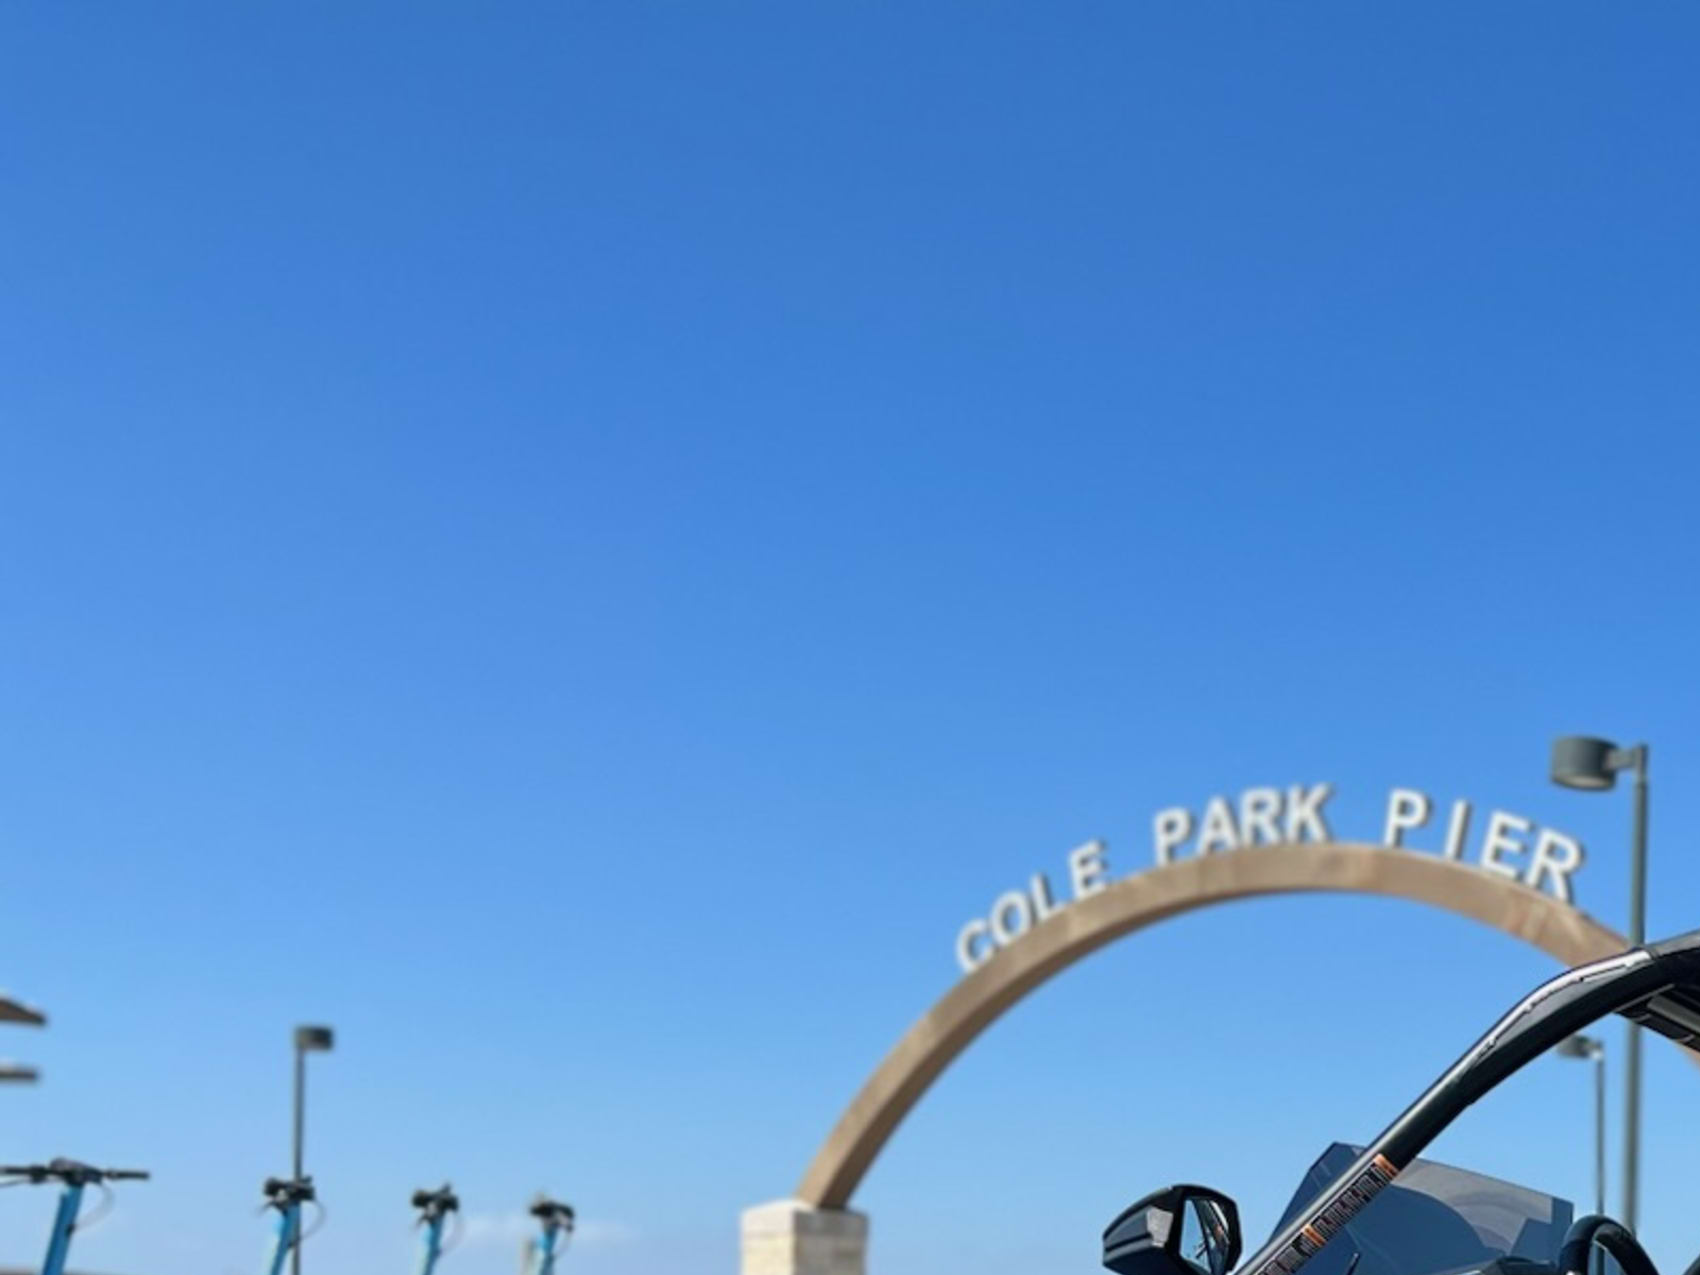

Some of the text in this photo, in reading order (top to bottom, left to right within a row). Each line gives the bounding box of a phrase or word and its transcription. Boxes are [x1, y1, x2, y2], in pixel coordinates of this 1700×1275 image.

[956, 784, 1583, 975] COLE PARK PIER
